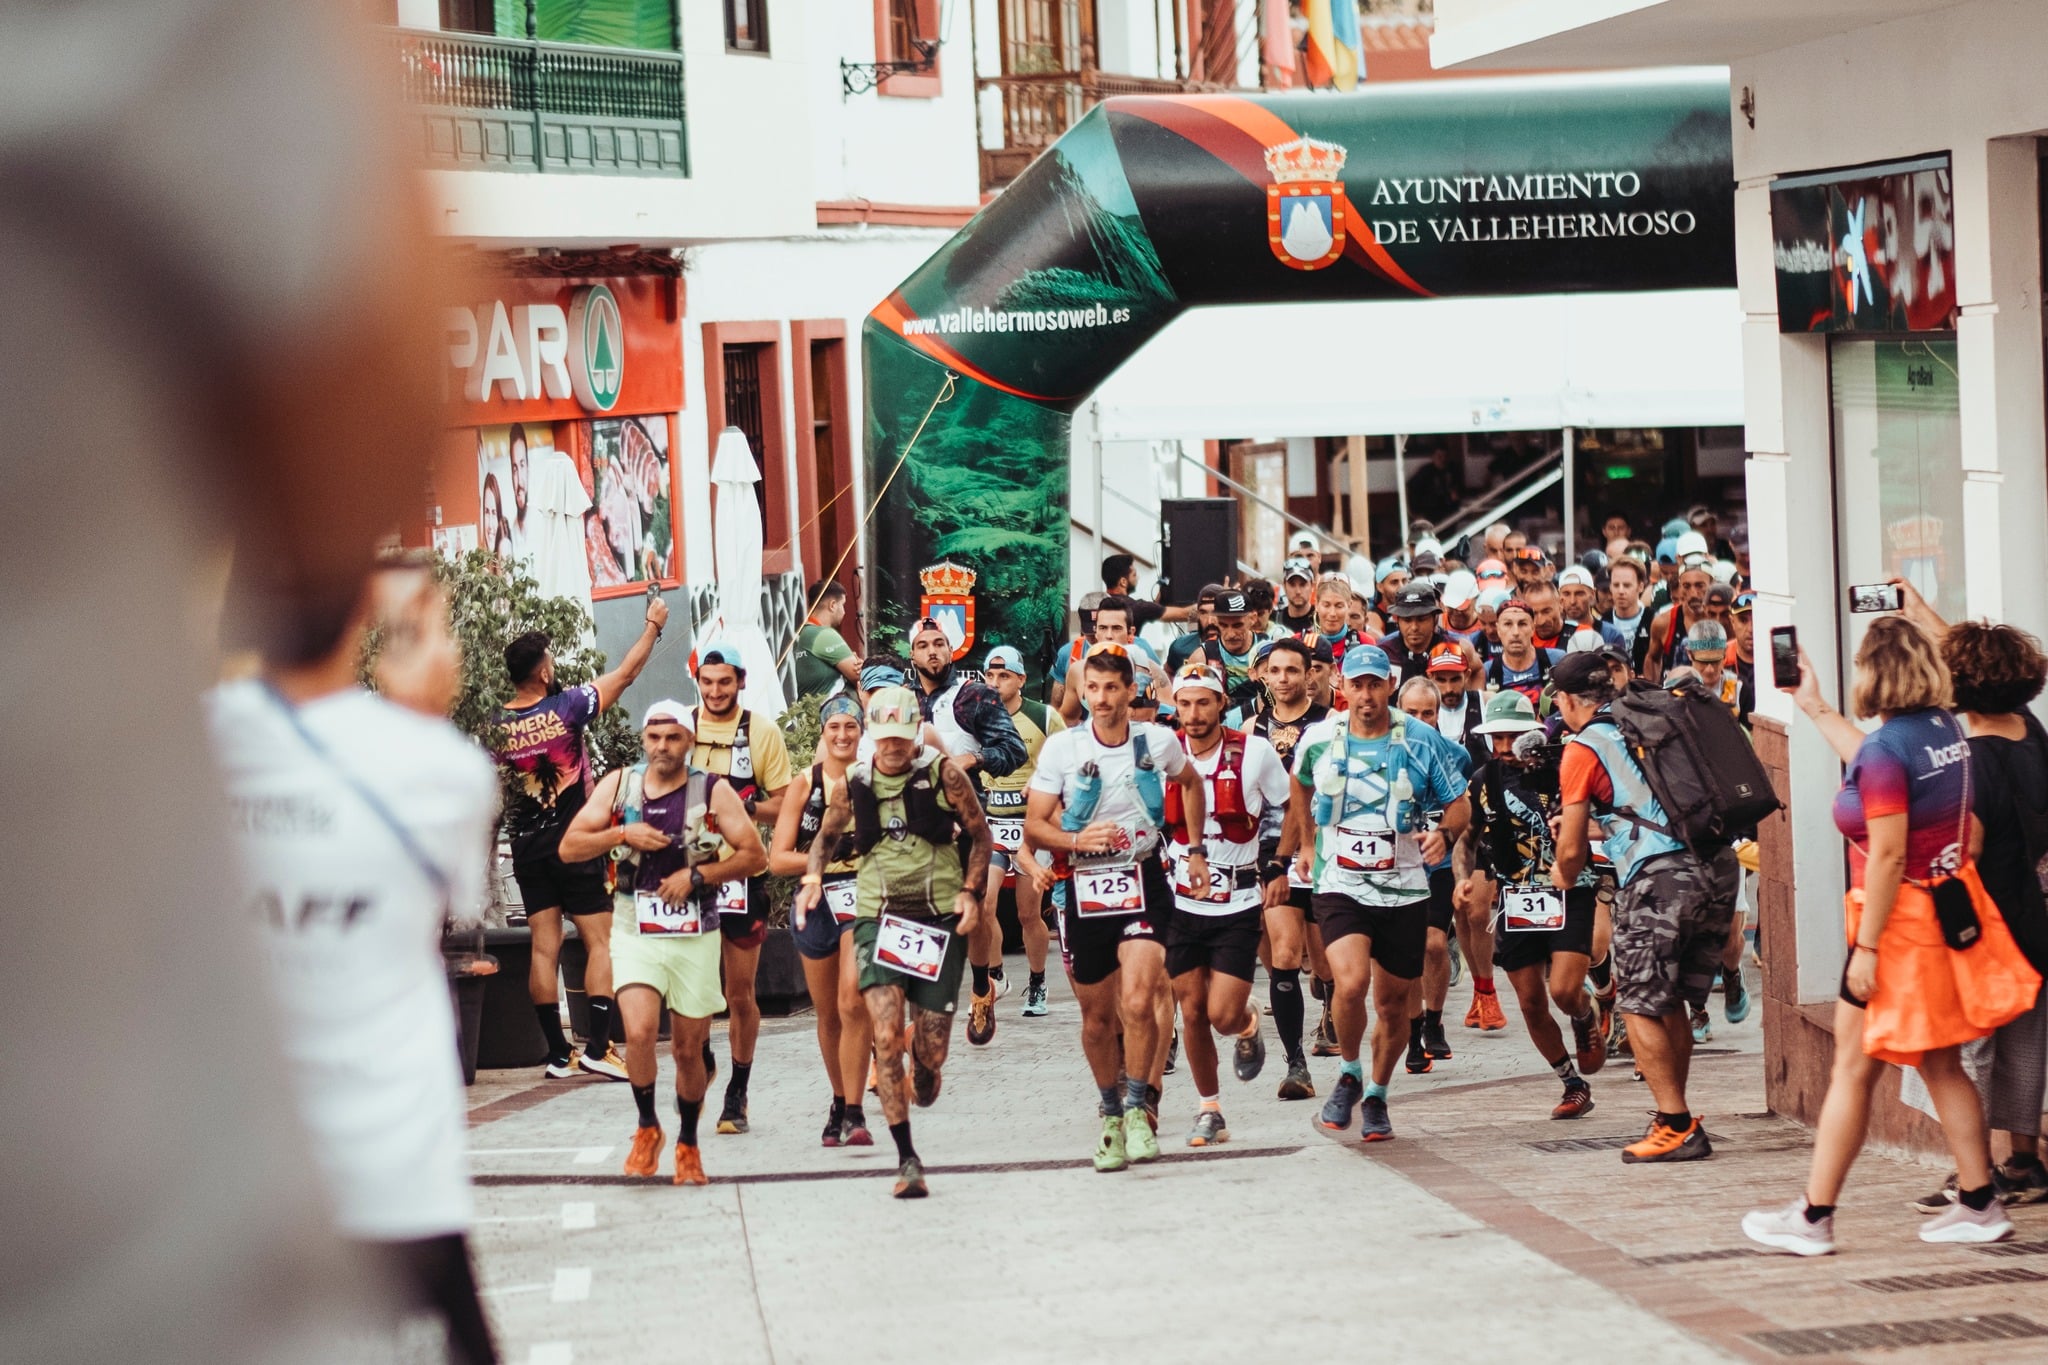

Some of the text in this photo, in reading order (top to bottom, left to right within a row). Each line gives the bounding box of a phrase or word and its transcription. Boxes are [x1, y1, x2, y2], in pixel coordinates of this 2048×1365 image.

[1371, 171, 1641, 205] AYUNTAMIENTO
[1372, 210, 1697, 245] DE VALLEHERMOSO
[902, 302, 1131, 336] www.vallehermosoweb.es
[444, 299, 572, 402] PAR
[500, 709, 561, 737] OMERA
[502, 721, 568, 752] RADISE
[1000, 828, 1021, 841] 20
[1351, 840, 1377, 856] 41
[1088, 877, 1130, 896] 125
[1210, 872, 1222, 888] 2
[842, 892, 855, 907] 3
[1522, 897, 1546, 913] 31
[898, 934, 924, 955] 51
